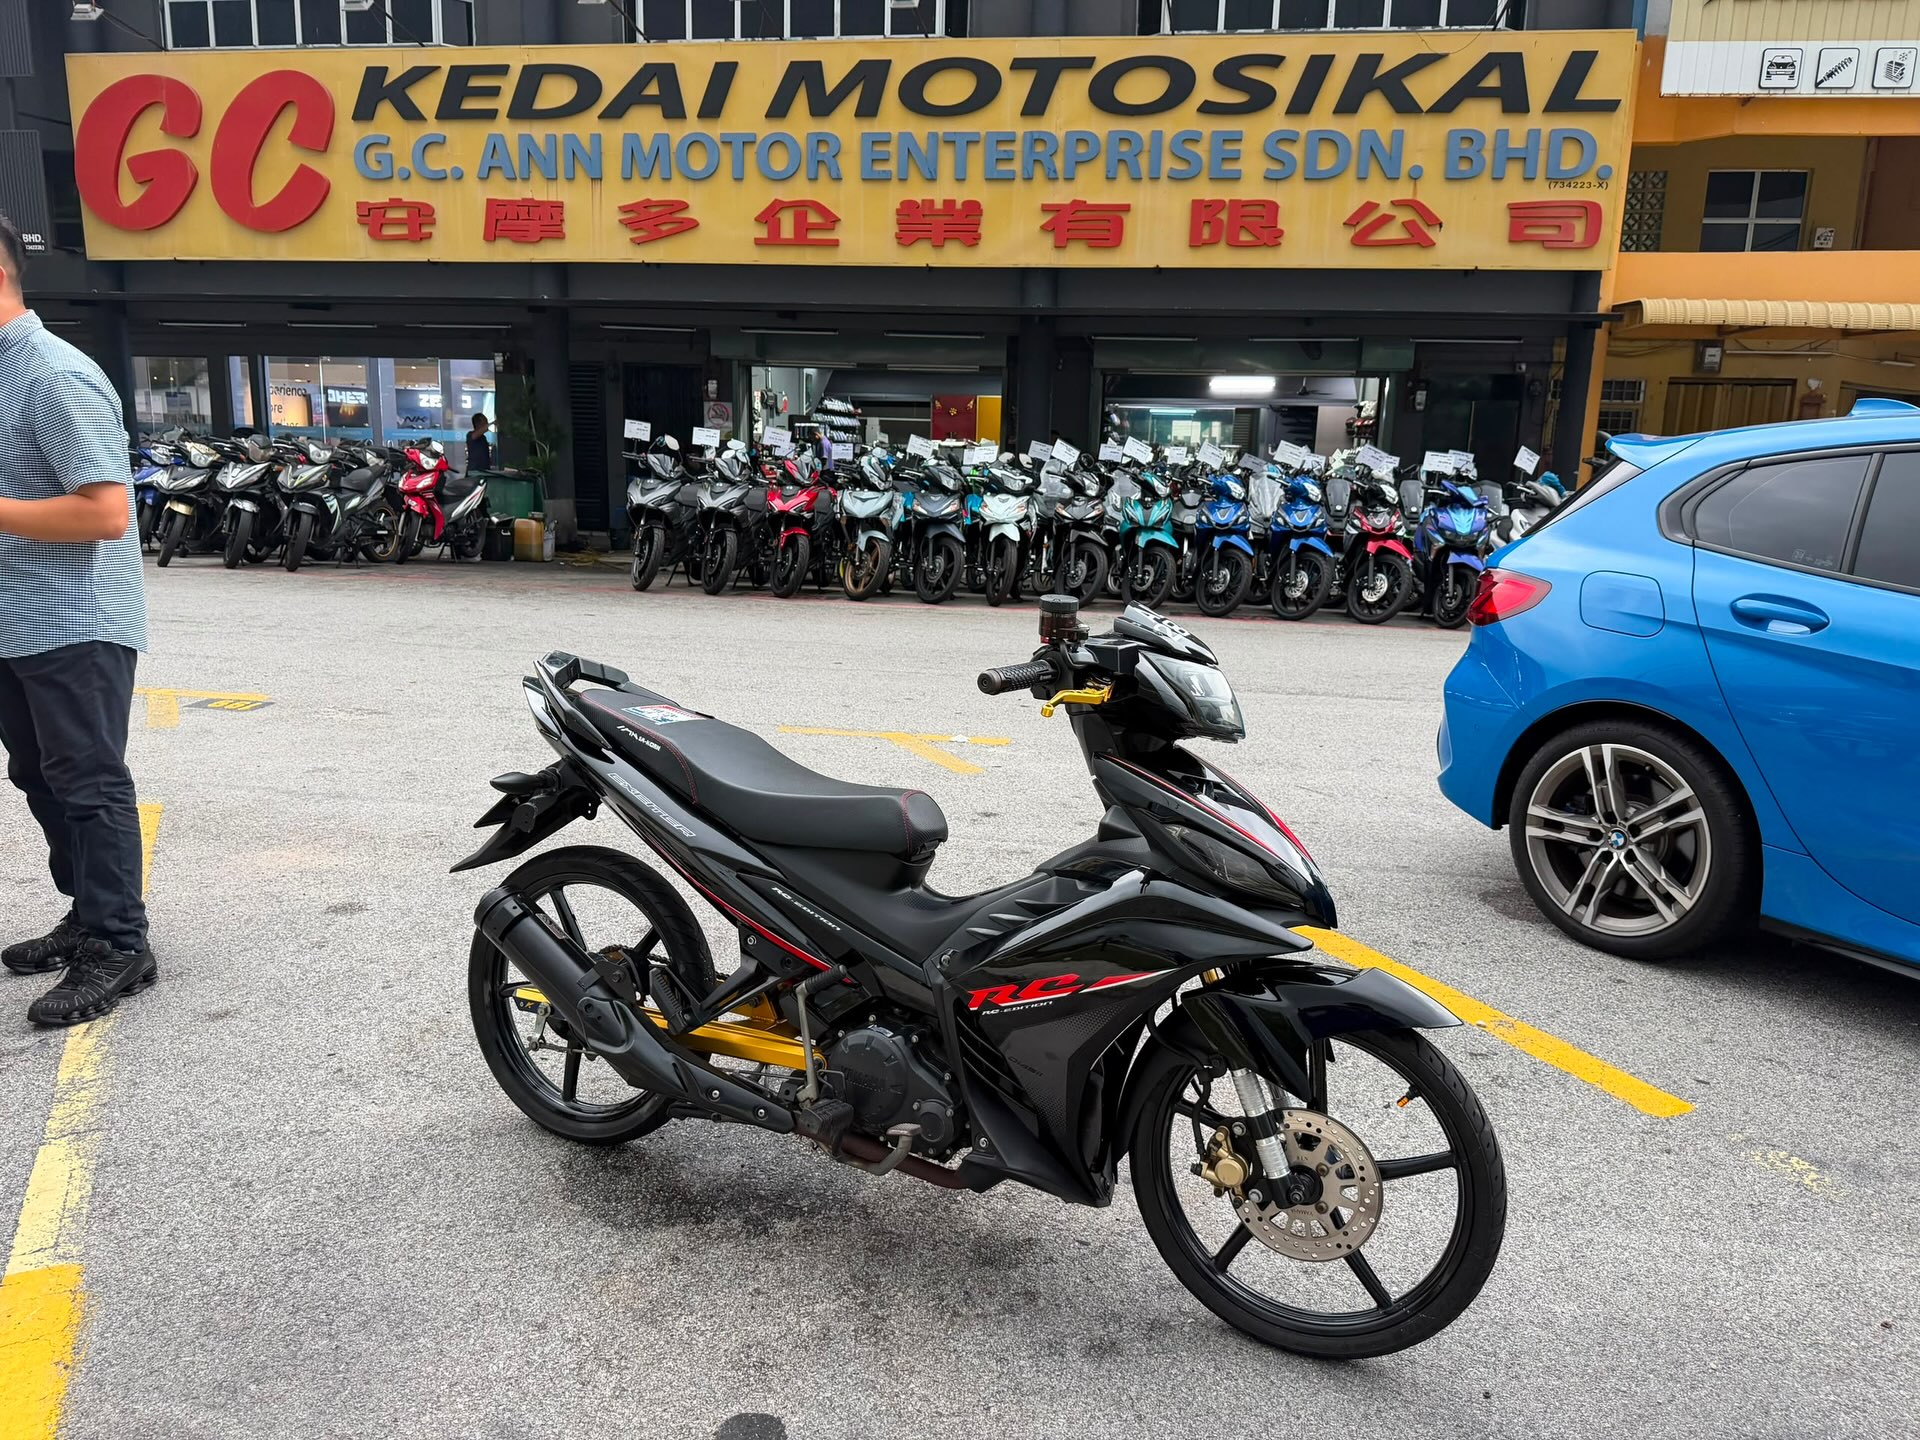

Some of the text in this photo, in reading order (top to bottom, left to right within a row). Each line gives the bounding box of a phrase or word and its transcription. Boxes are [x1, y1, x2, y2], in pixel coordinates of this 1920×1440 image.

[351, 50, 1622, 121] KEDAI MOTOSIKAL
[74, 70, 336, 233] GC
[354, 129, 1613, 181] G.C. ANN MOTOR ENTERPRISE SDN. BHD.
[1548, 181, 1609, 190] (734223-X)
[22, 233, 45, 243] BHD.
[356, 198, 1604, 249] 安摩多企業有限公司
[967, 972, 1085, 1011] RC
